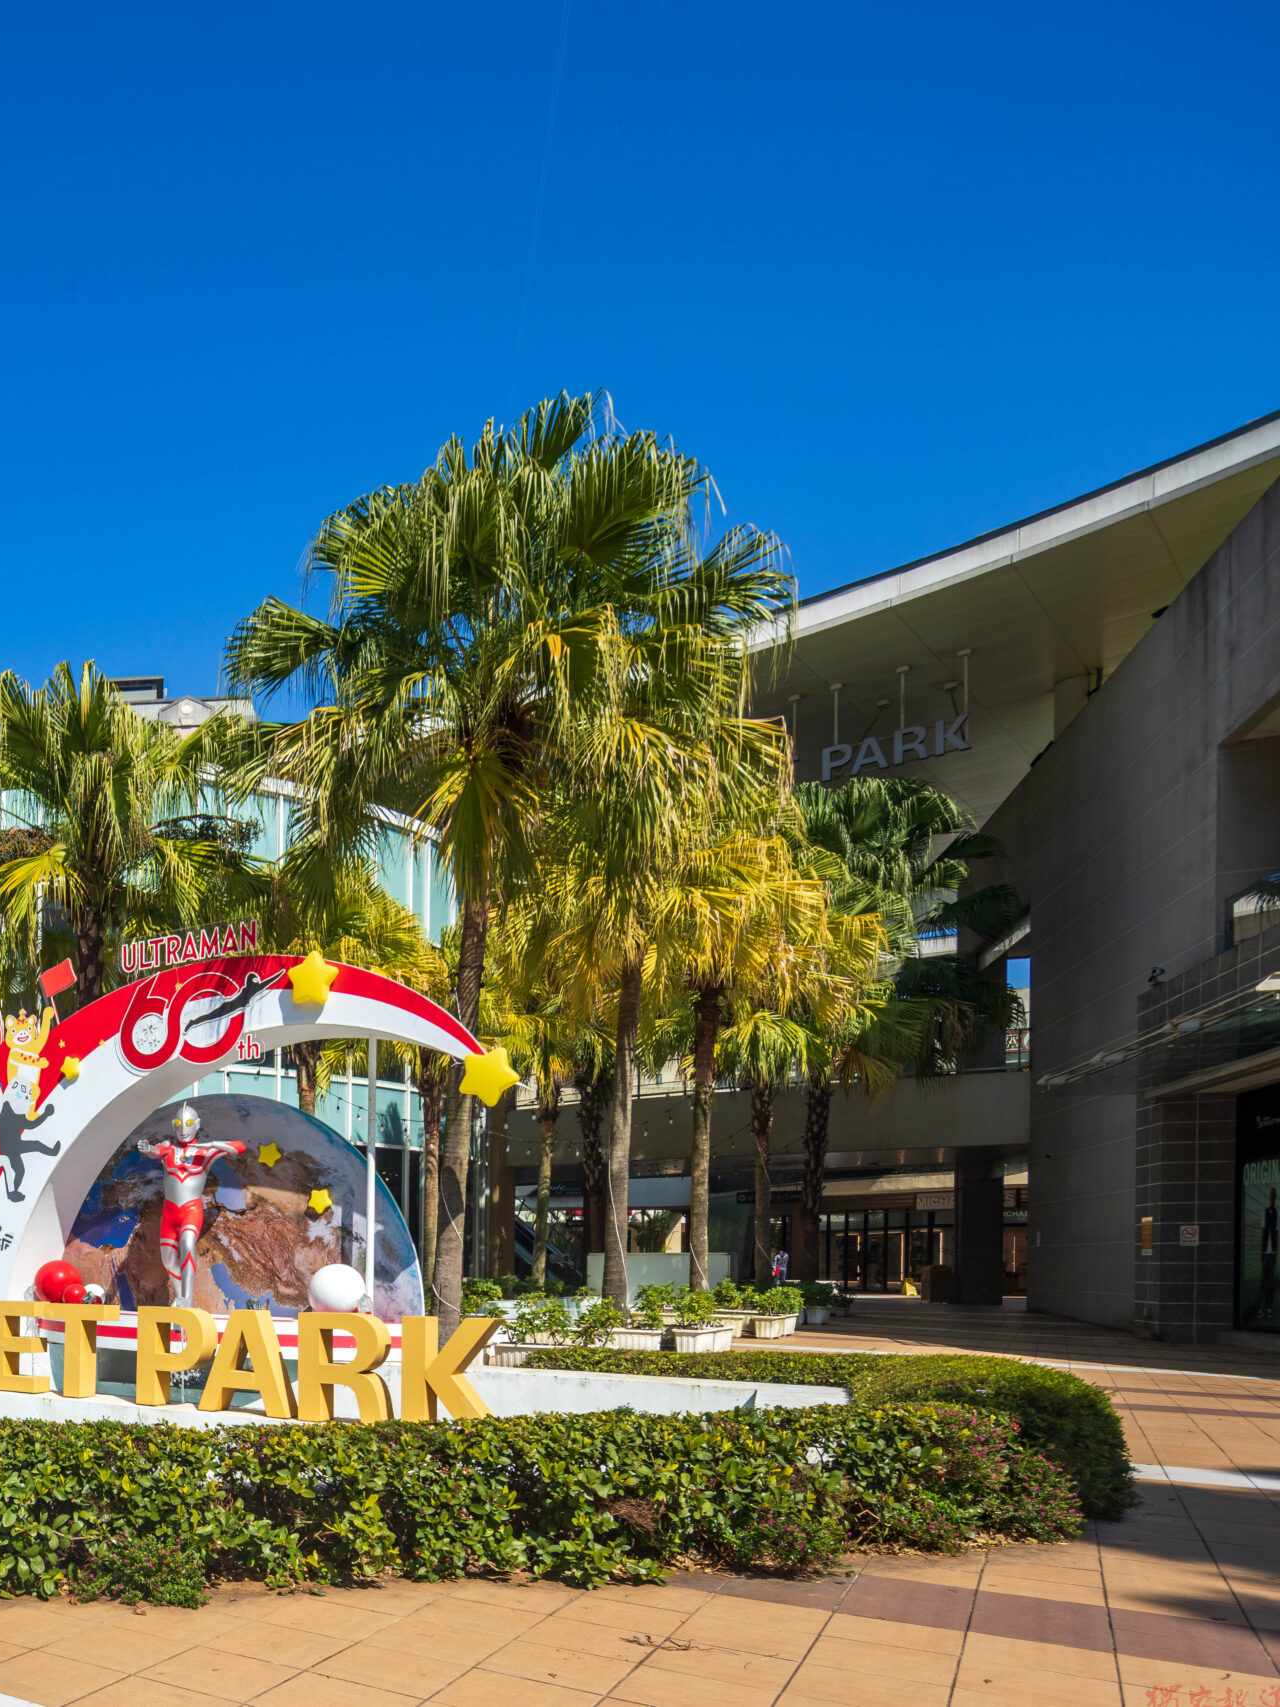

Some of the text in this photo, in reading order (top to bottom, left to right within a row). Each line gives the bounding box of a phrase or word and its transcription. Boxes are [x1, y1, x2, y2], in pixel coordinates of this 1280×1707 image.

[821, 713, 972, 782] PARK
[121, 920, 258, 973] ULTRAMAN
[136, 1305, 506, 1423] PARK
